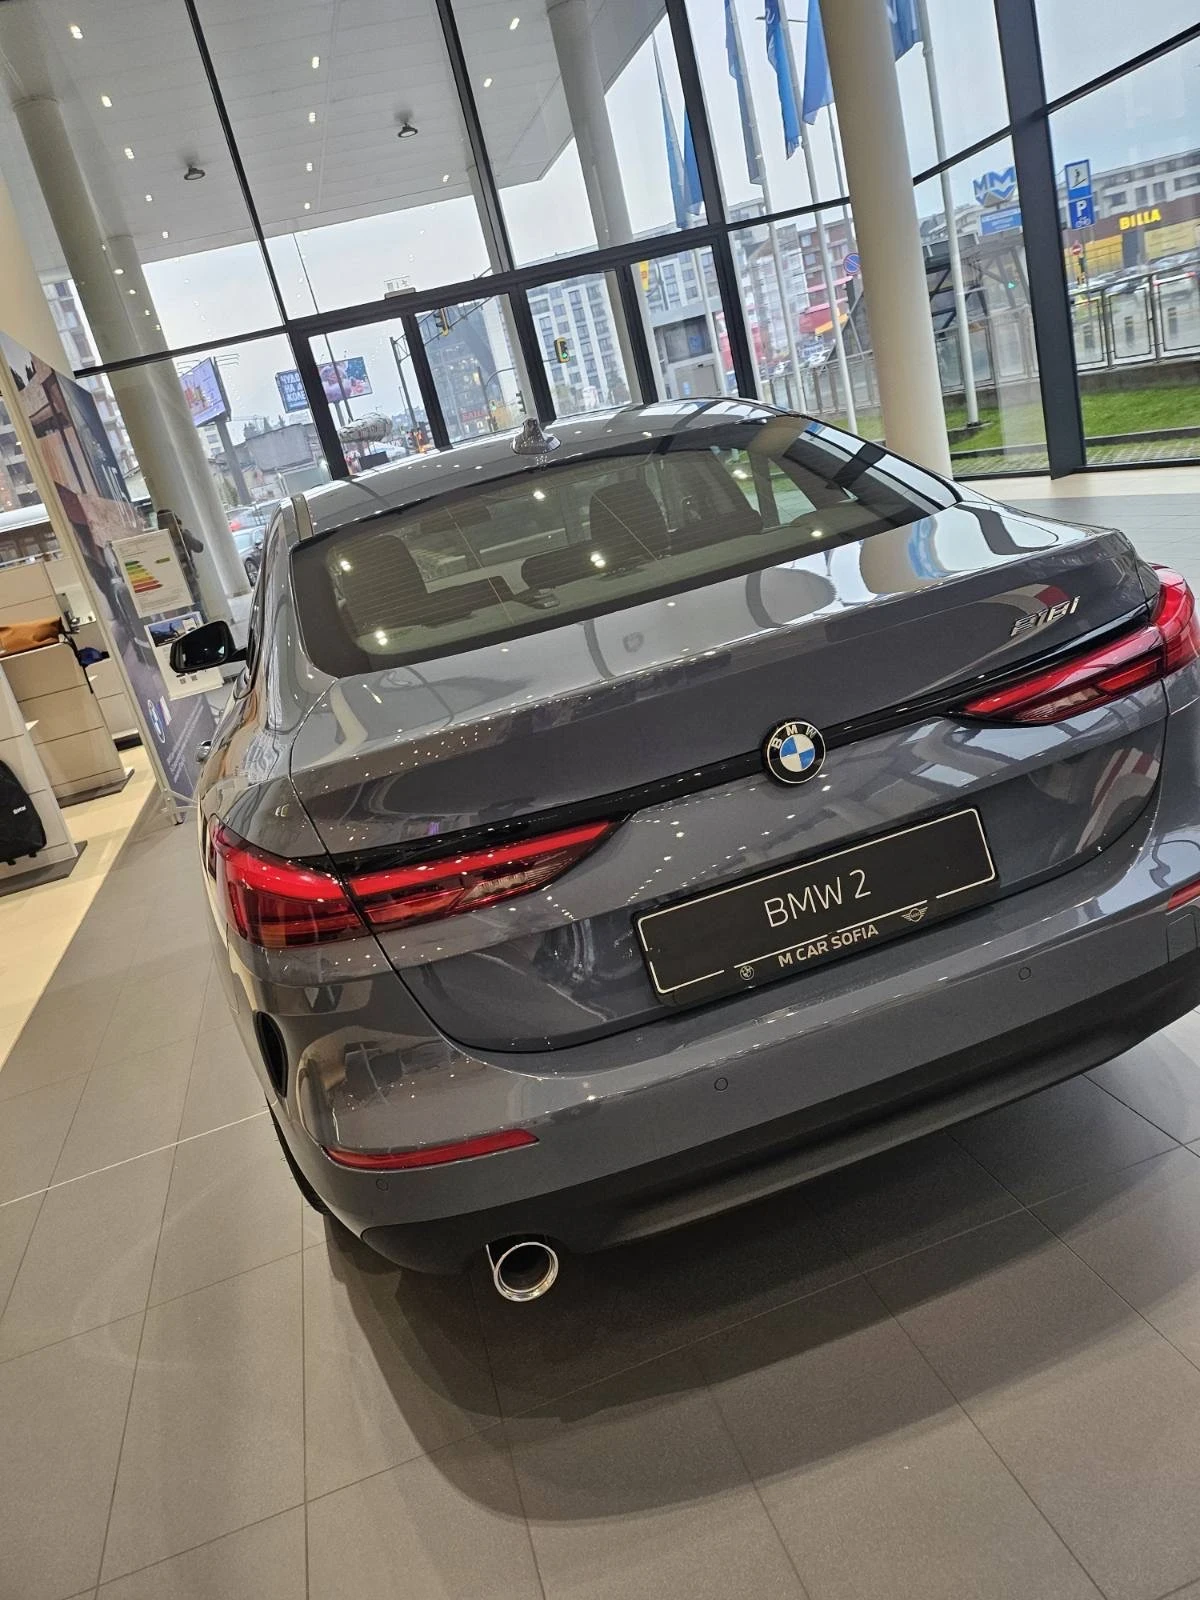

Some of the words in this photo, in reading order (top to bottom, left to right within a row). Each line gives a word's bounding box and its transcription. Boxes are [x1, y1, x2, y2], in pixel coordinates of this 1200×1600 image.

[1076, 199, 1088, 218] P
[1119, 208, 1162, 231] BILLA
[286, 391, 307, 403] КОЛЕ
[770, 724, 817, 750] BMW
[764, 876, 842, 928] BMW
[849, 869, 872, 899] 2
[778, 953, 793, 968] M
[796, 940, 829, 961] CAR
[831, 924, 879, 950] SOFIA
